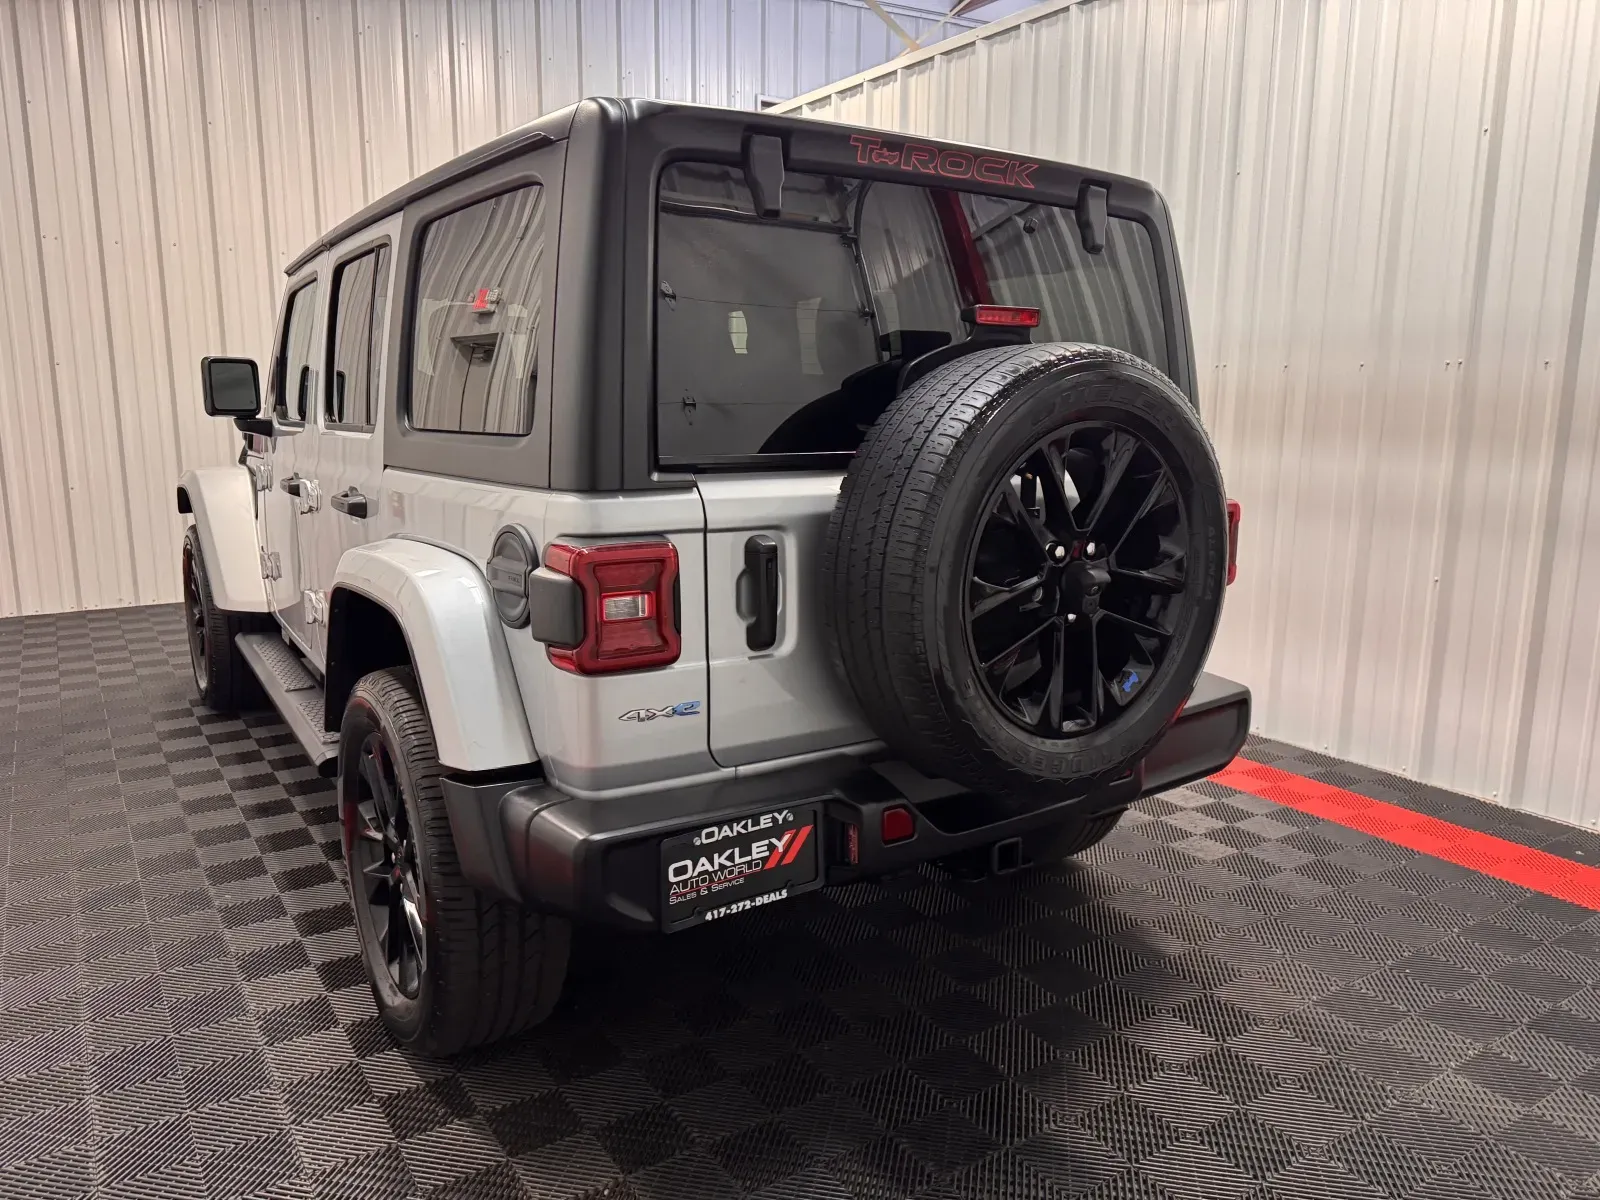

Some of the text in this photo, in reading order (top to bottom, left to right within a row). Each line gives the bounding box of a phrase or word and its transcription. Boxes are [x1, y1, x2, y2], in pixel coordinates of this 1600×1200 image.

[701, 810, 789, 844] OAKLEY
[668, 834, 792, 882] OAKLEY
[669, 860, 762, 896] AUTO WORLD
[699, 886, 709, 896] &
[704, 888, 788, 921] 417-272-DEALS
